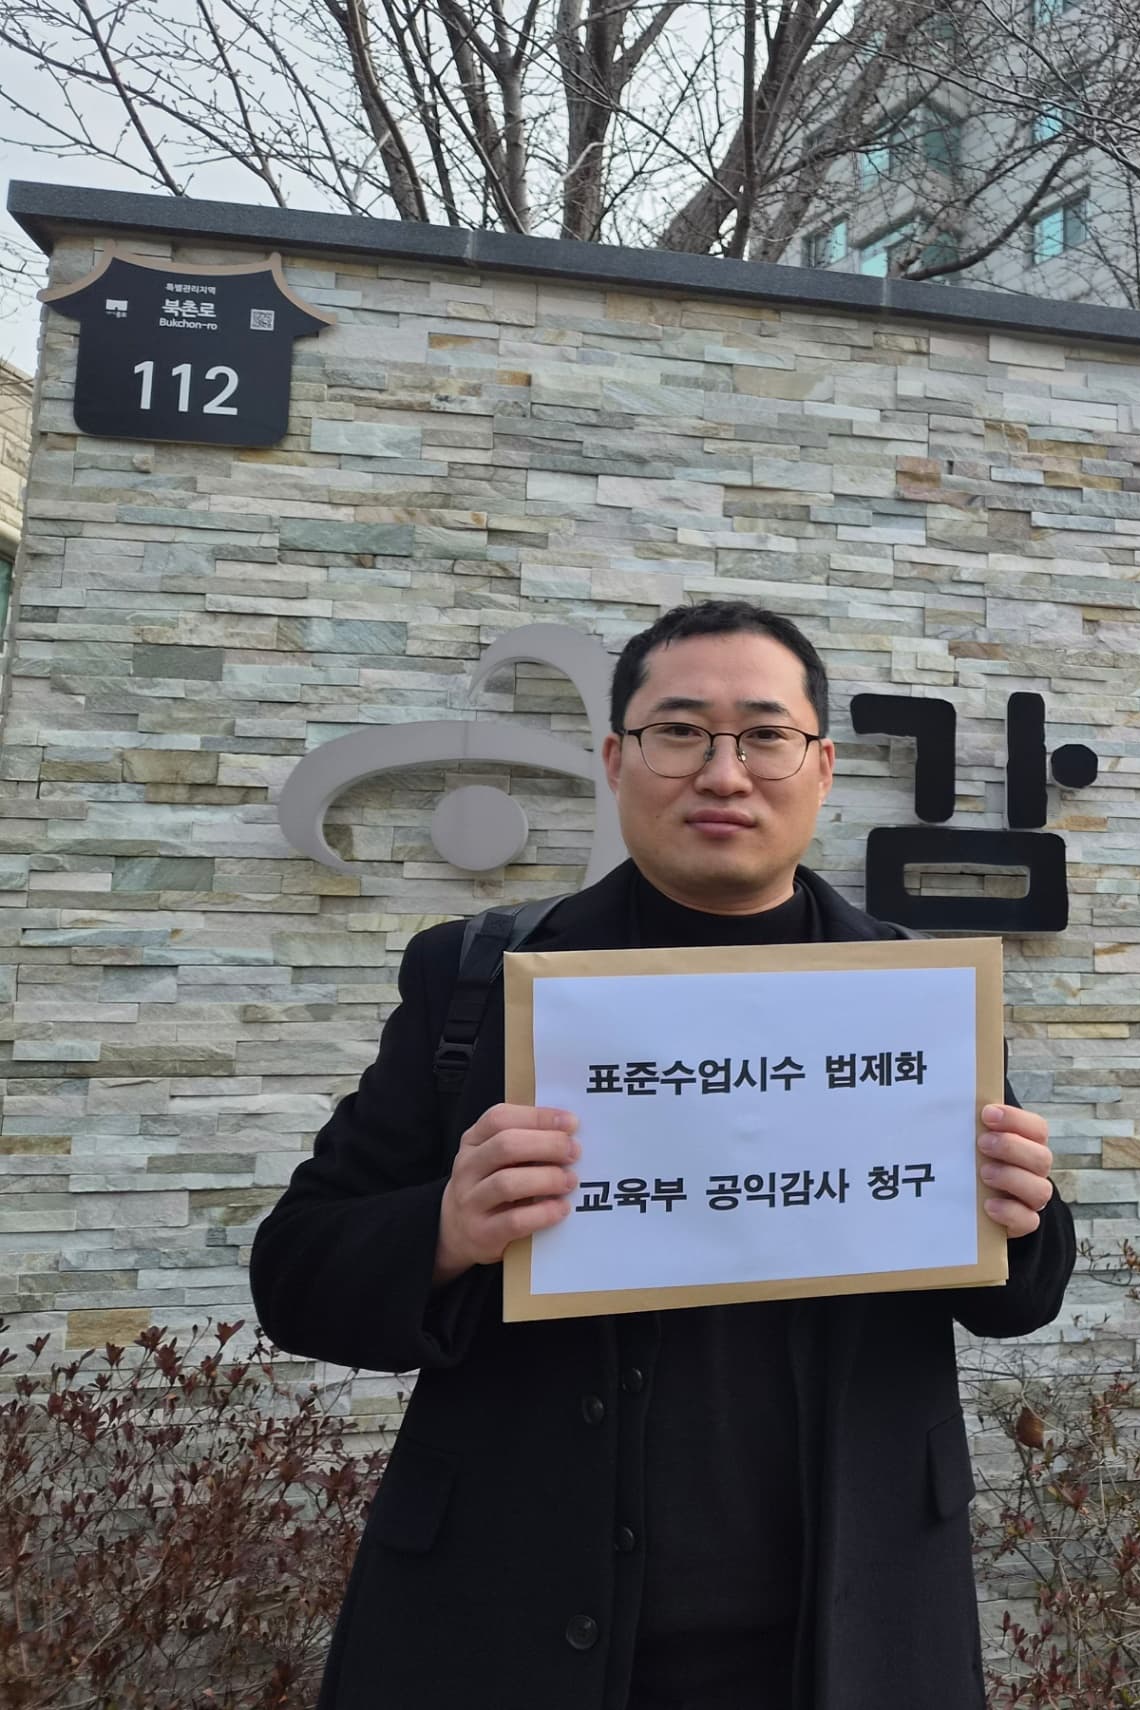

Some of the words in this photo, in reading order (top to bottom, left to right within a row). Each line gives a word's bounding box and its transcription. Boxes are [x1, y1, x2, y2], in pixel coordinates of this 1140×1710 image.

[159, 317, 218, 330] Bukchon-ro
[162, 299, 216, 317] 북촌로
[133, 360, 239, 415] 112
[586, 1056, 806, 1095] 표준수업시수
[825, 1050, 928, 1089] 법제화
[575, 1176, 687, 1213] 교육부
[706, 1167, 849, 1210] 공익감사
[867, 1163, 936, 1201] 청구
